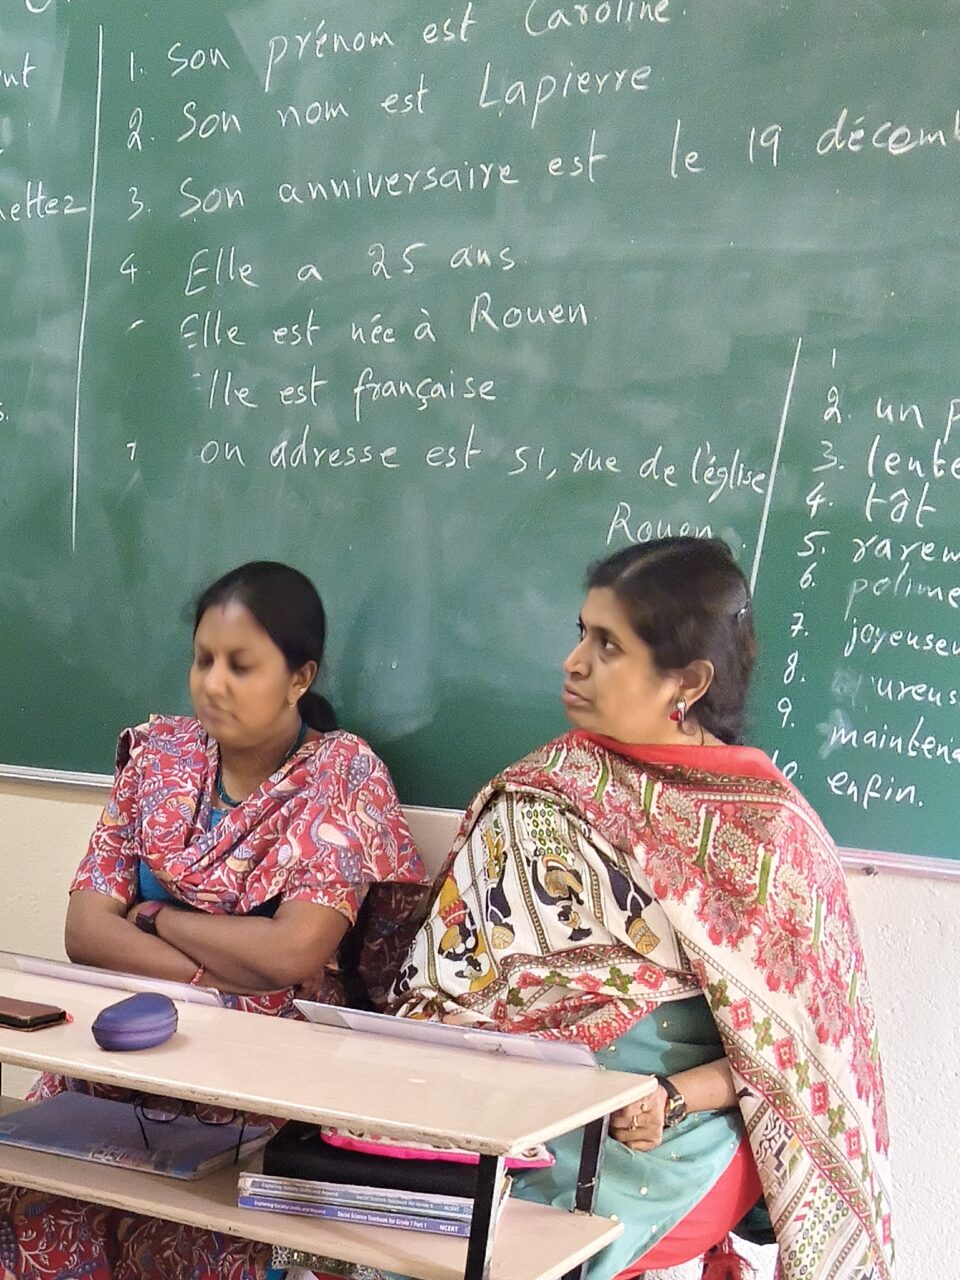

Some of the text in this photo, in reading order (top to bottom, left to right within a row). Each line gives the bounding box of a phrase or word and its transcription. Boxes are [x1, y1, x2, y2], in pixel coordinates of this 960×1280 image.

[264, 19, 397, 93] prénom
[422, 1, 478, 45] est
[176, 101, 242, 143] Son
[276, 100, 349, 128] nom
[380, 73, 430, 114] est
[178, 176, 245, 223] Son
[278, 160, 520, 204] anniversaire
[548, 128, 608, 183] est
[670, 118, 705, 179] le
[748, 124, 783, 167] 19
[184, 245, 259, 297] Elle
[296, 264, 324, 283] a
[367, 241, 427, 280] 25
[179, 309, 246, 350] Elle
[272, 308, 321, 347] est
[351, 313, 396, 345] née
[413, 307, 436, 343] à
[191, 364, 497, 423] lle est française
[876, 396, 925, 431] un
[269, 424, 401, 470] adresse
[425, 423, 482, 469] est
[570, 447, 622, 473] rue
[639, 445, 678, 488] de
[440, 1224, 458, 1232] NCERT
